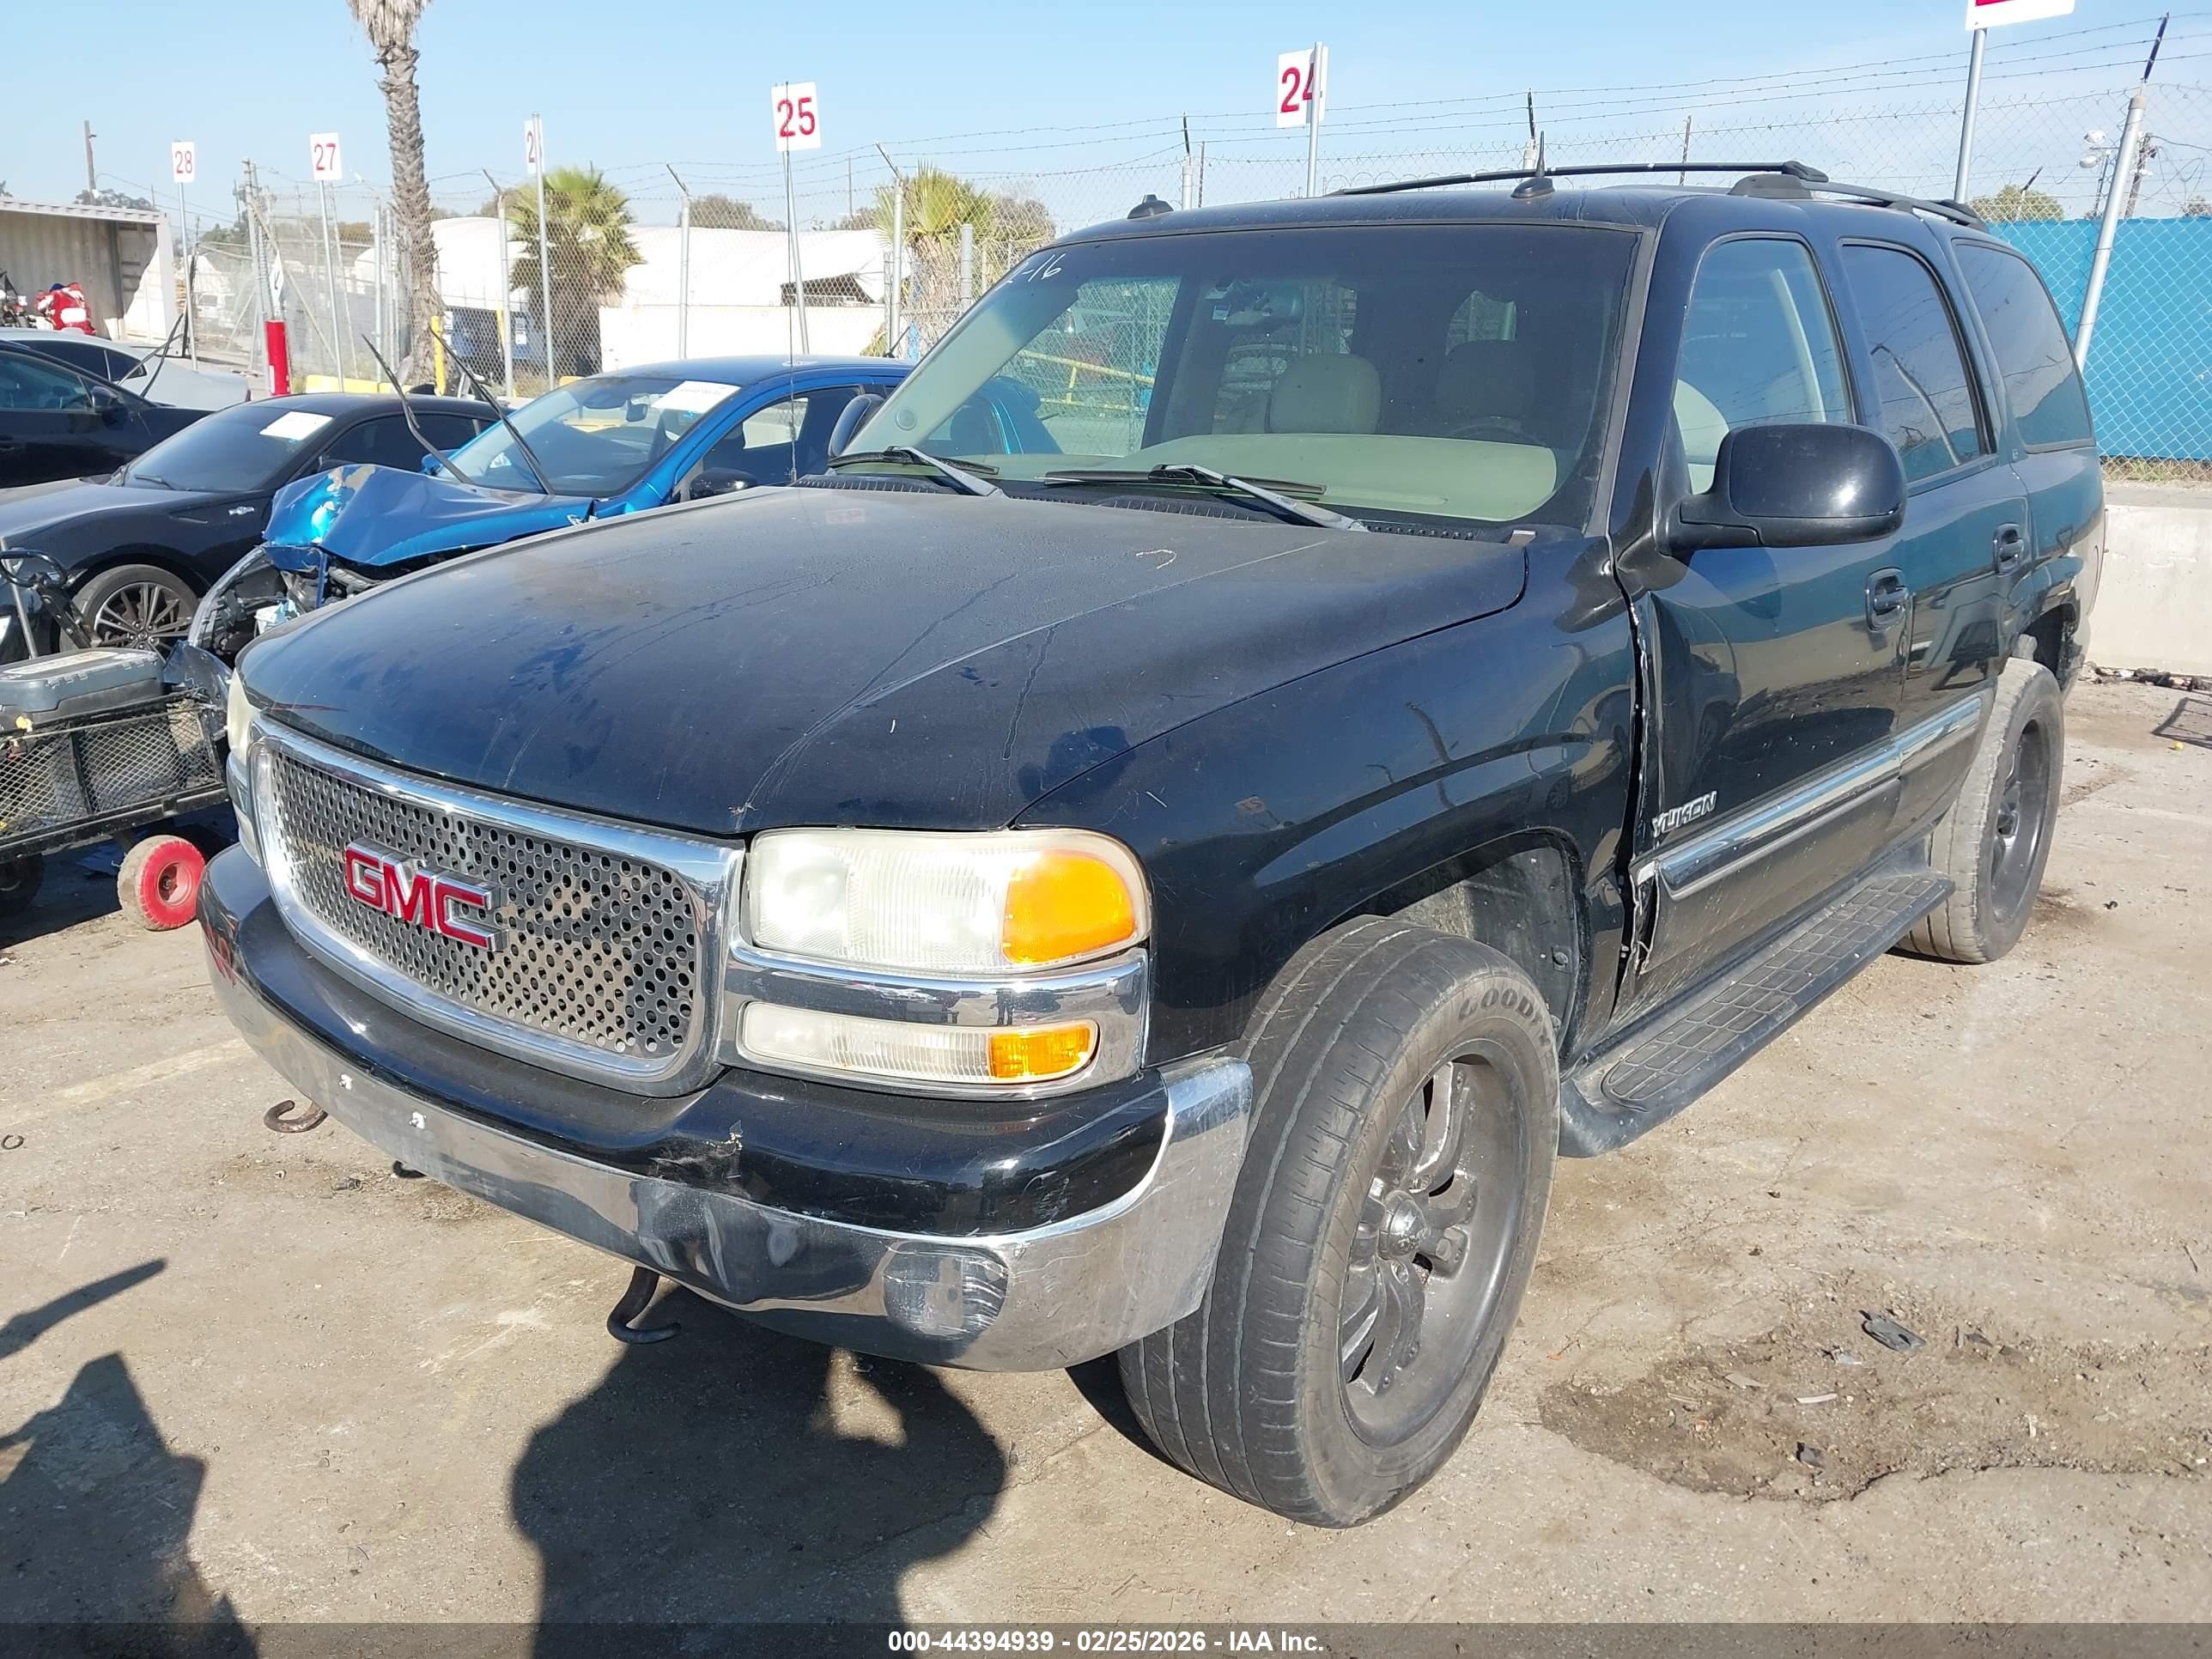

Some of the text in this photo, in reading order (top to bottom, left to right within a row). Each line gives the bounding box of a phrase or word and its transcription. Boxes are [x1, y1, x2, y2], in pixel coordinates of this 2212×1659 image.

[777, 96, 816, 137] 25
[174, 150, 194, 174] 28
[313, 143, 337, 171] 27
[1651, 790, 1717, 838] YUKON
[345, 841, 500, 951] GMC
